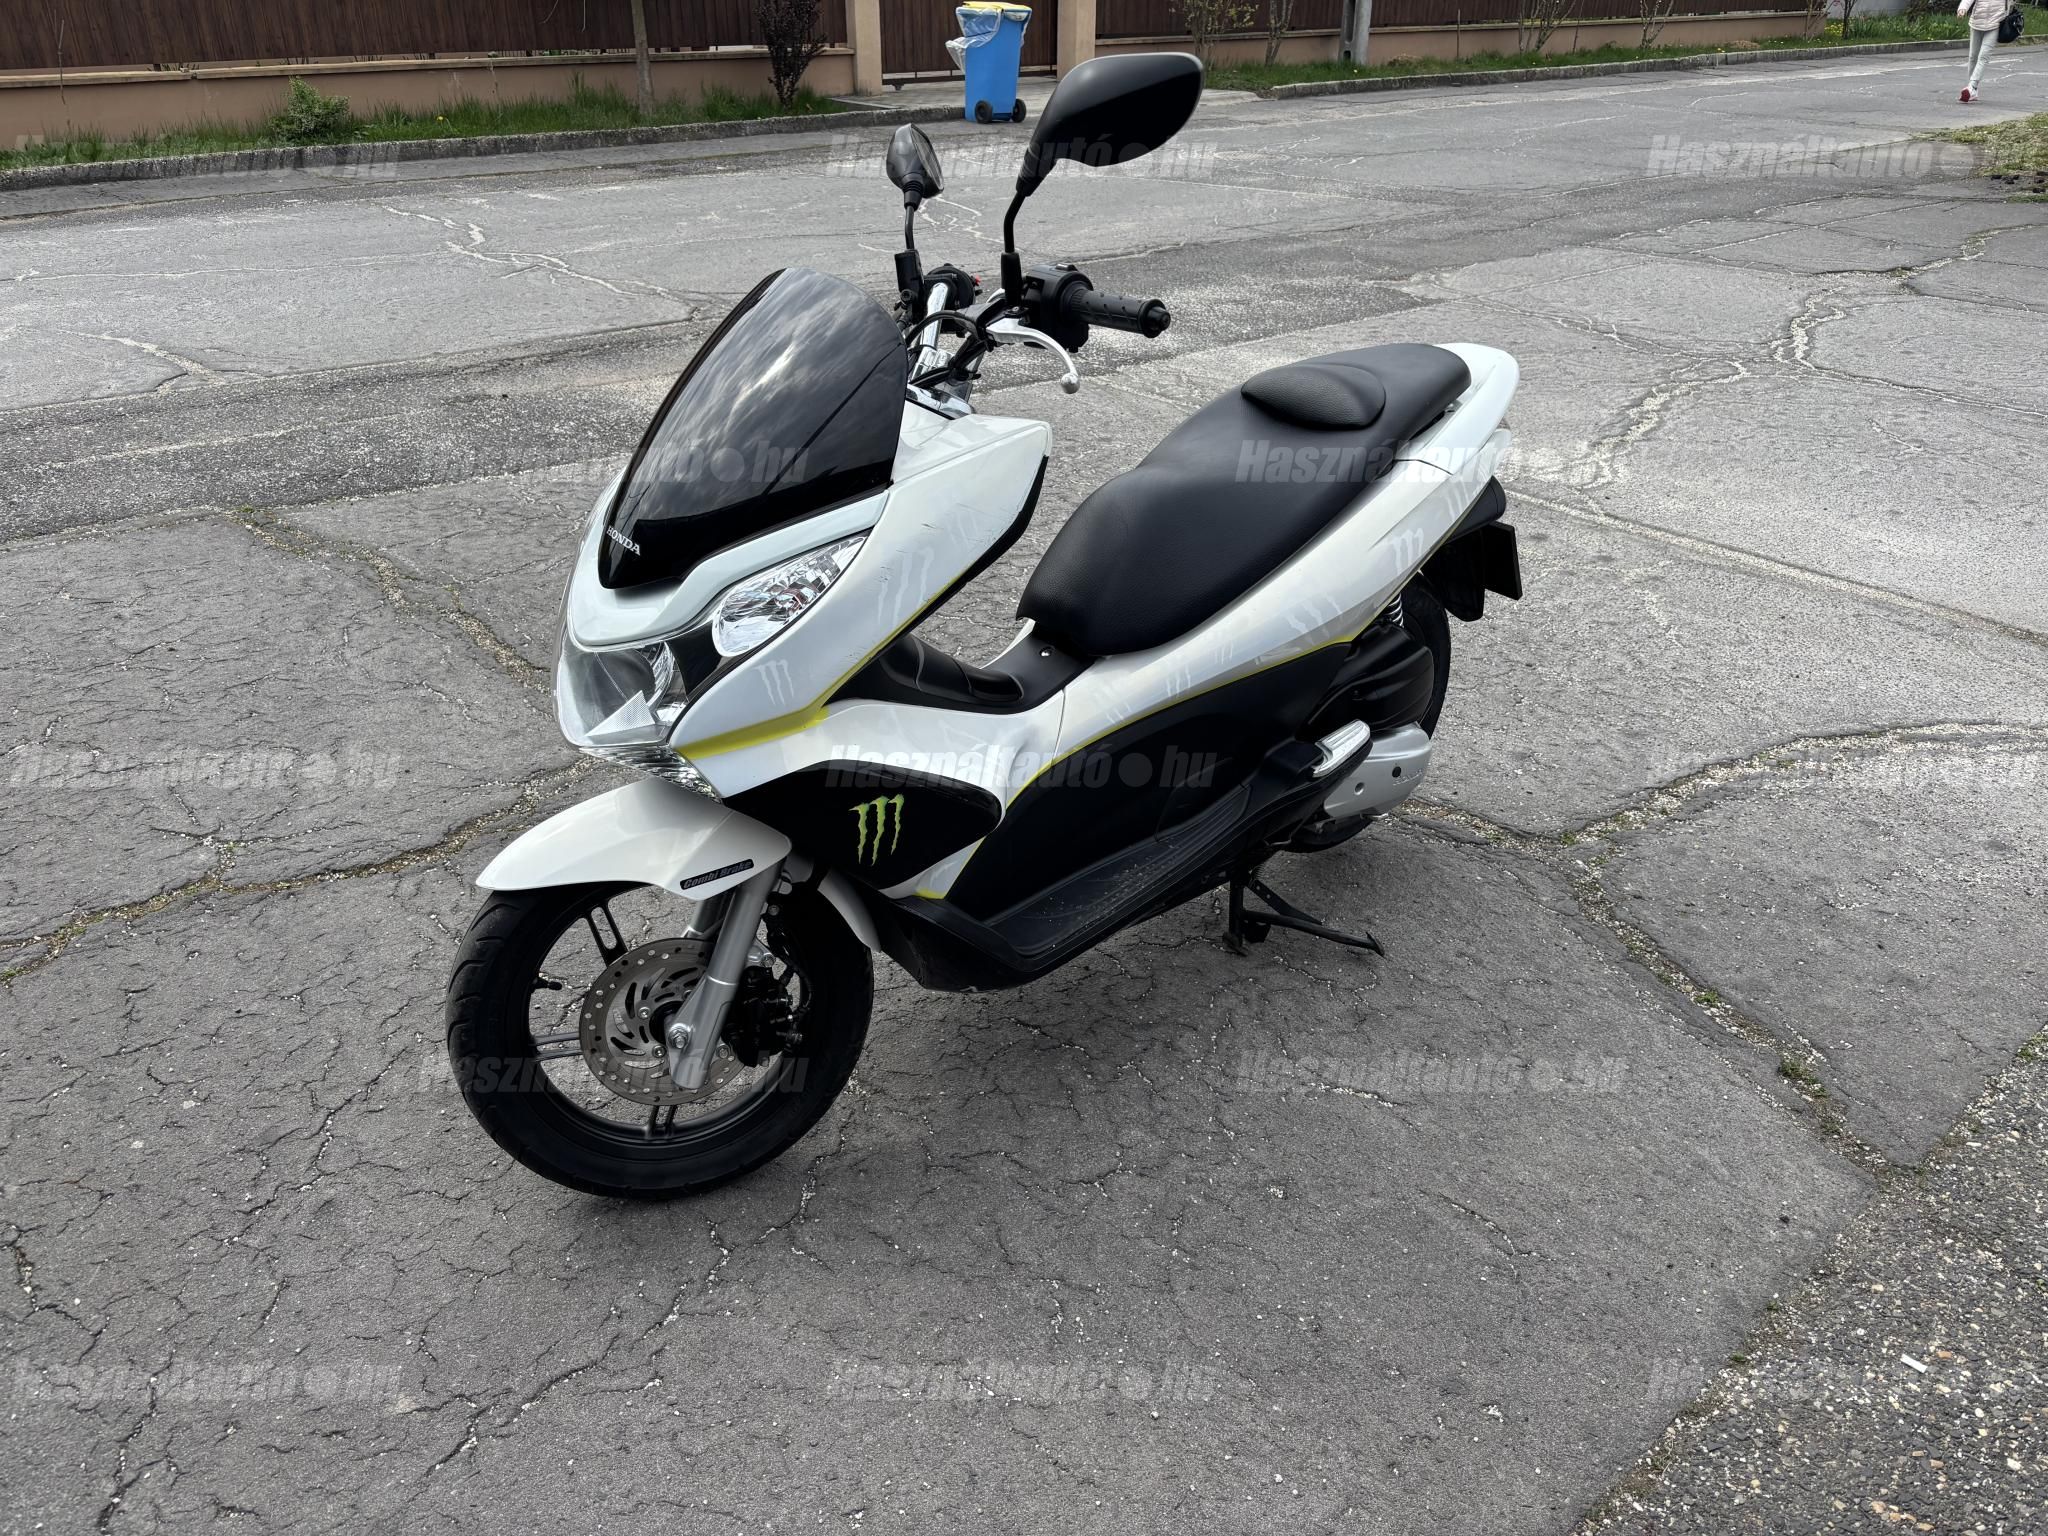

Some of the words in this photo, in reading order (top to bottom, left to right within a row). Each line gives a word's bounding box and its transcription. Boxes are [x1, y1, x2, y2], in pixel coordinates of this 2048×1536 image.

[606, 525, 641, 556] HONDA
[682, 871, 719, 889] Combi
[719, 861, 752, 878] Brake
